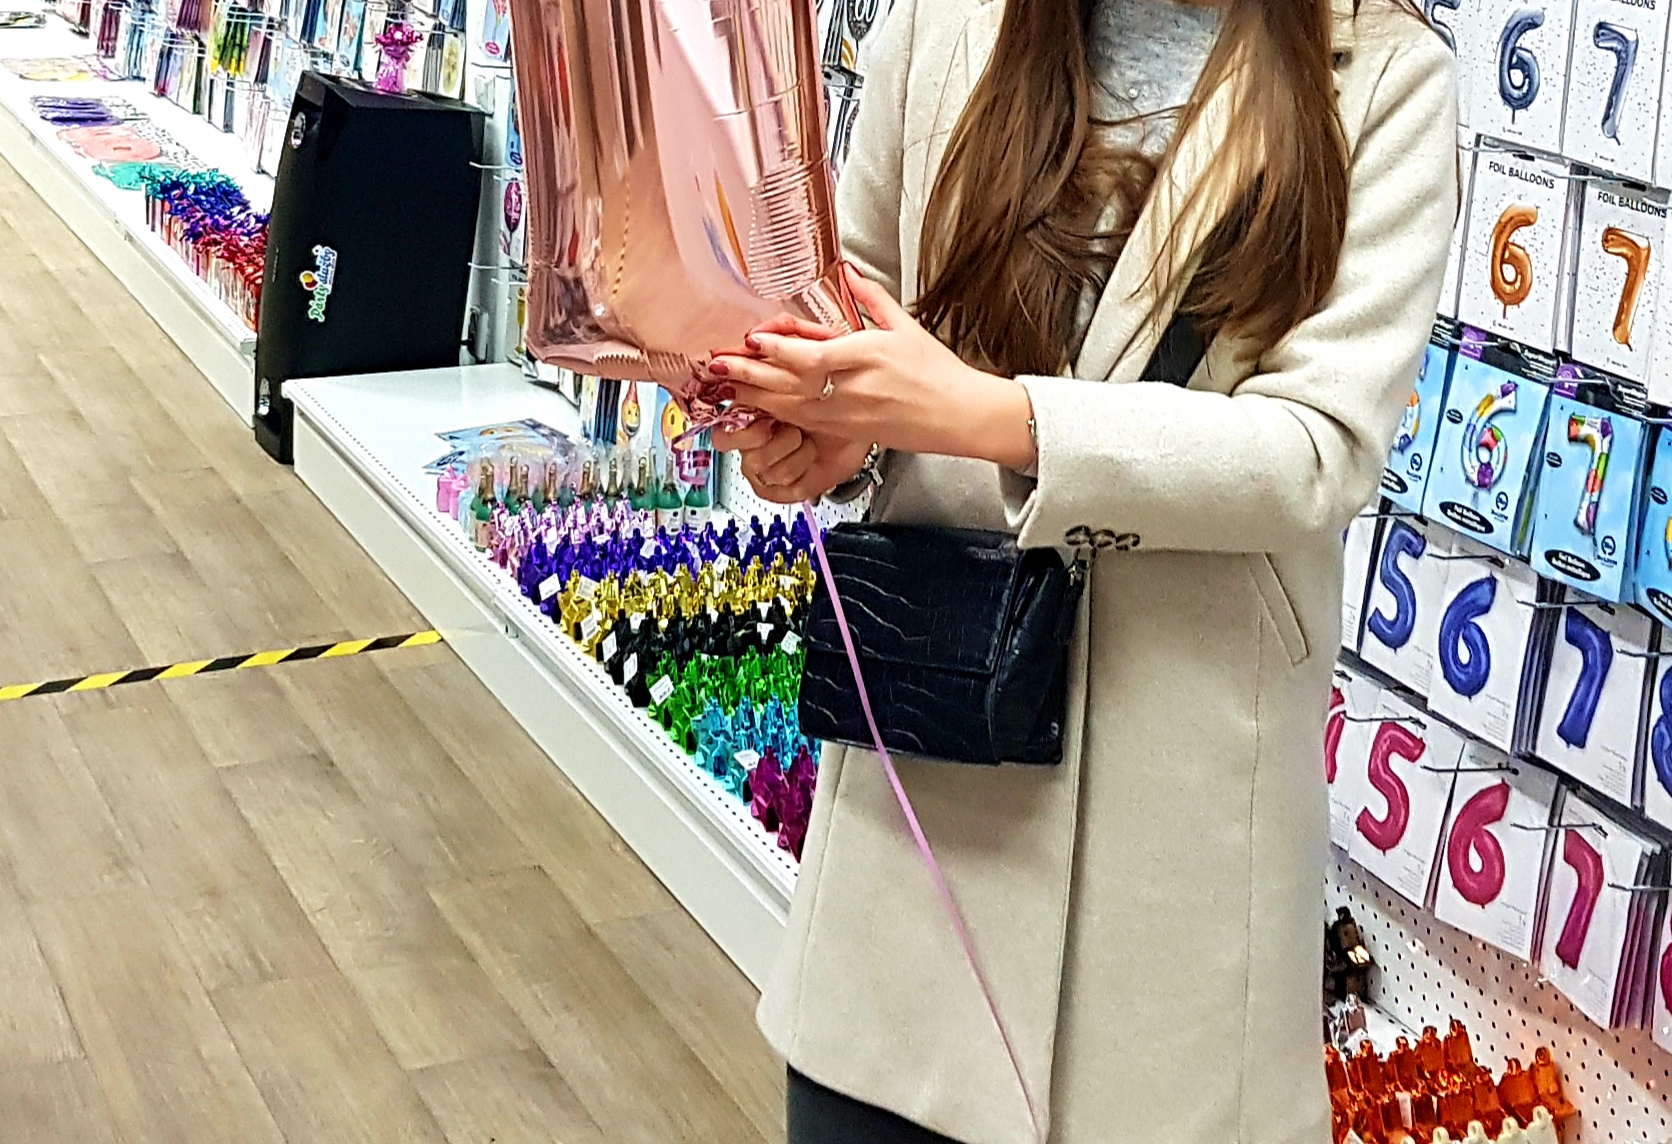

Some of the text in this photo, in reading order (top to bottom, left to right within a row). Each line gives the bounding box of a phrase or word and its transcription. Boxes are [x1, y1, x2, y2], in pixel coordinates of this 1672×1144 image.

[1496, 5, 1546, 112] 6
[1593, 20, 1640, 142] 7
[1489, 160, 1556, 190] FOIL BALLOONS
[1597, 191, 1668, 219] FOIL BALLOONS
[1489, 202, 1540, 307] 6
[1601, 224, 1652, 348] 7
[1461, 379, 1519, 491] 6
[1368, 518, 1427, 653] 5
[1438, 572, 1499, 699] 6
[1556, 604, 1614, 749] 7
[1355, 722, 1427, 853] 5
[1447, 778, 1510, 908] 6
[1555, 829, 1604, 970] 7
